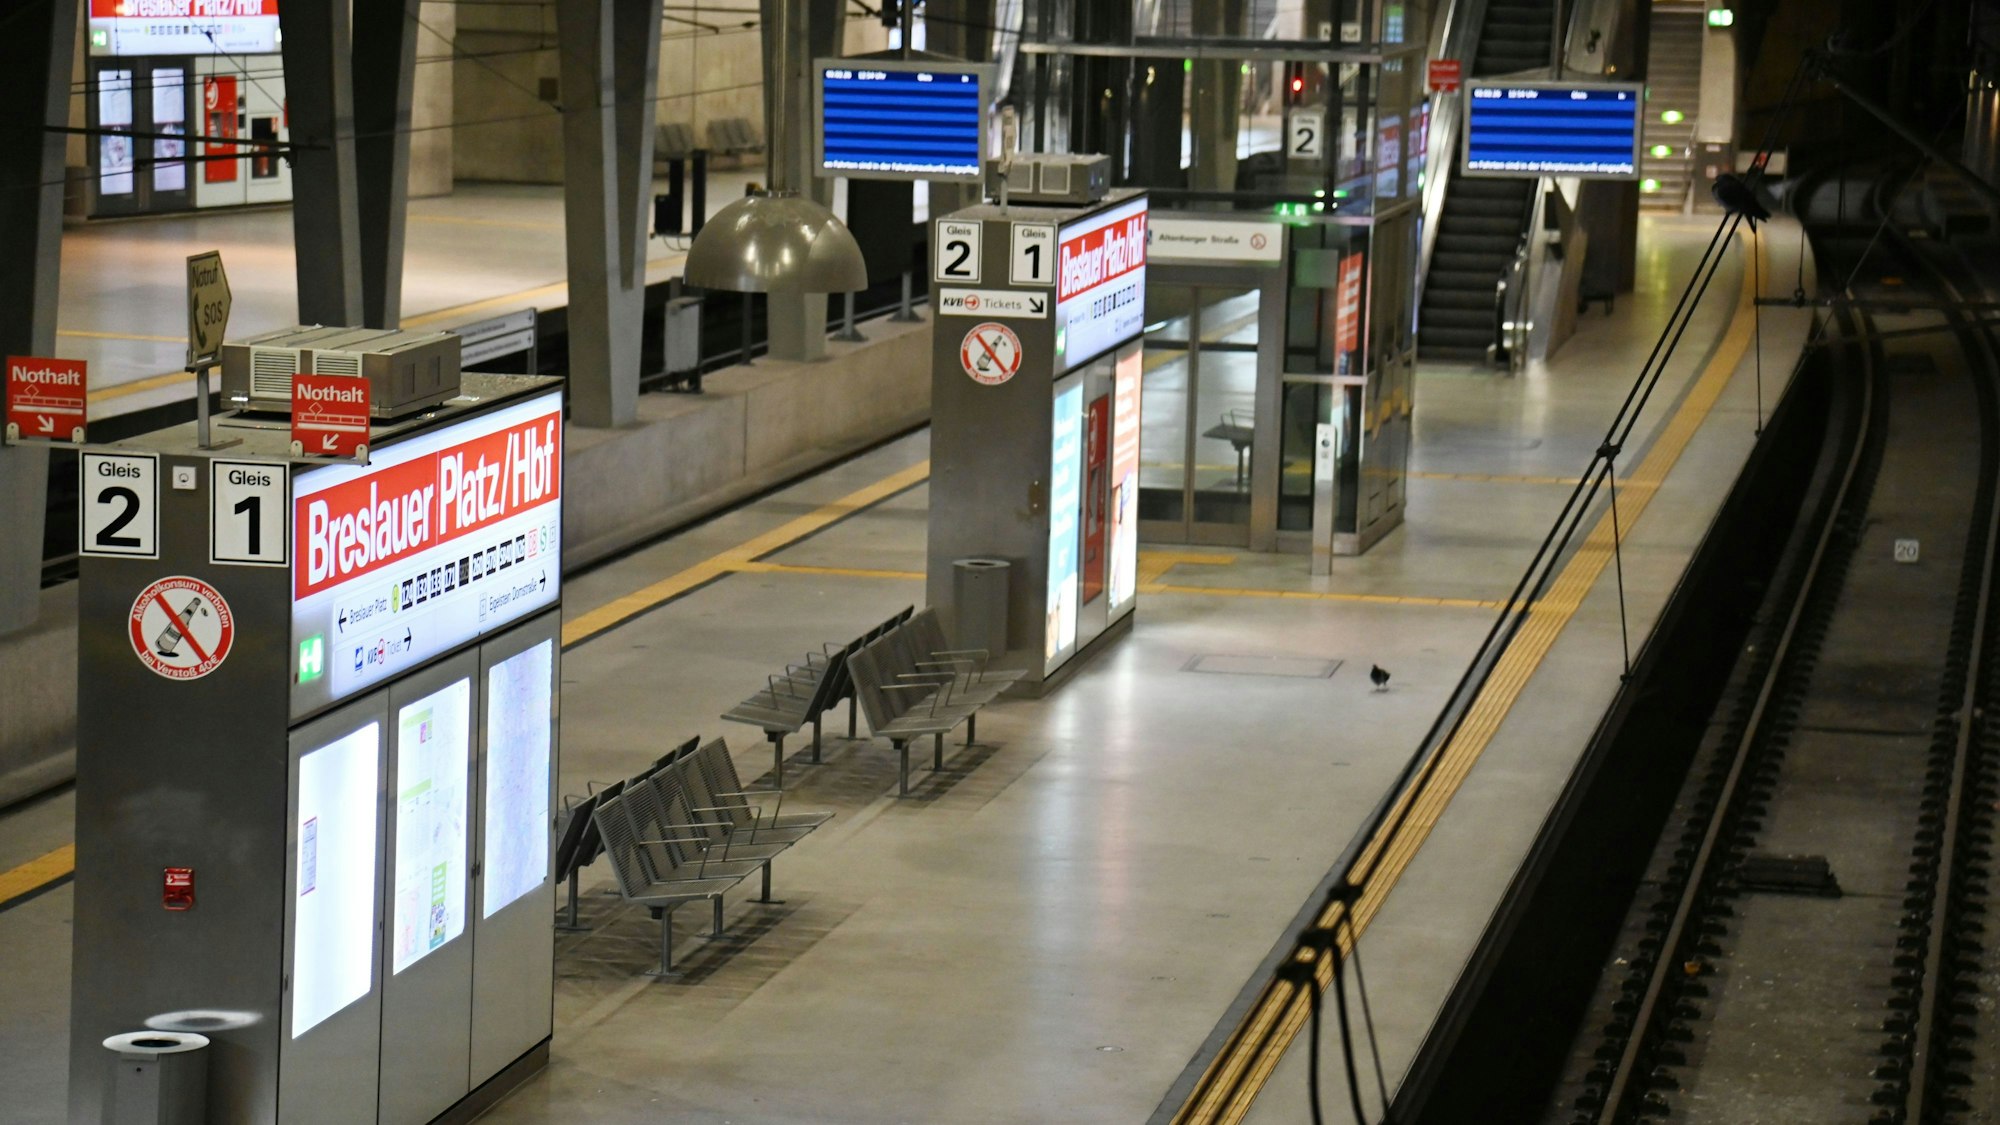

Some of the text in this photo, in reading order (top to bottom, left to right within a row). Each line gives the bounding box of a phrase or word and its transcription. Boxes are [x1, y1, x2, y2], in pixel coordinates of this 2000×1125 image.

[1296, 127, 1315, 154] 2
[946, 225, 971, 236] Gleis
[1022, 228, 1046, 239] Gleis
[945, 240, 970, 276] 2
[1025, 244, 1040, 279] 1
[1061, 239, 1104, 298] Breslauer
[191, 261, 218, 288] Notruf
[204, 300, 222, 326] SOS
[943, 297, 1022, 310] KVB Tickets
[12, 365, 81, 386] Nothalt
[297, 383, 364, 403] Nothalt
[98, 461, 141, 479] Gleis
[228, 470, 271, 487] Gleis
[308, 420, 554, 586] Breslauer Platz/Hbf
[96, 486, 141, 548] 2
[234, 496, 261, 555] 1
[1897, 544, 1916, 558] 20
[133, 580, 229, 628] Alkoholkonsum verboten
[141, 650, 219, 677] bei Verstoß 40€
